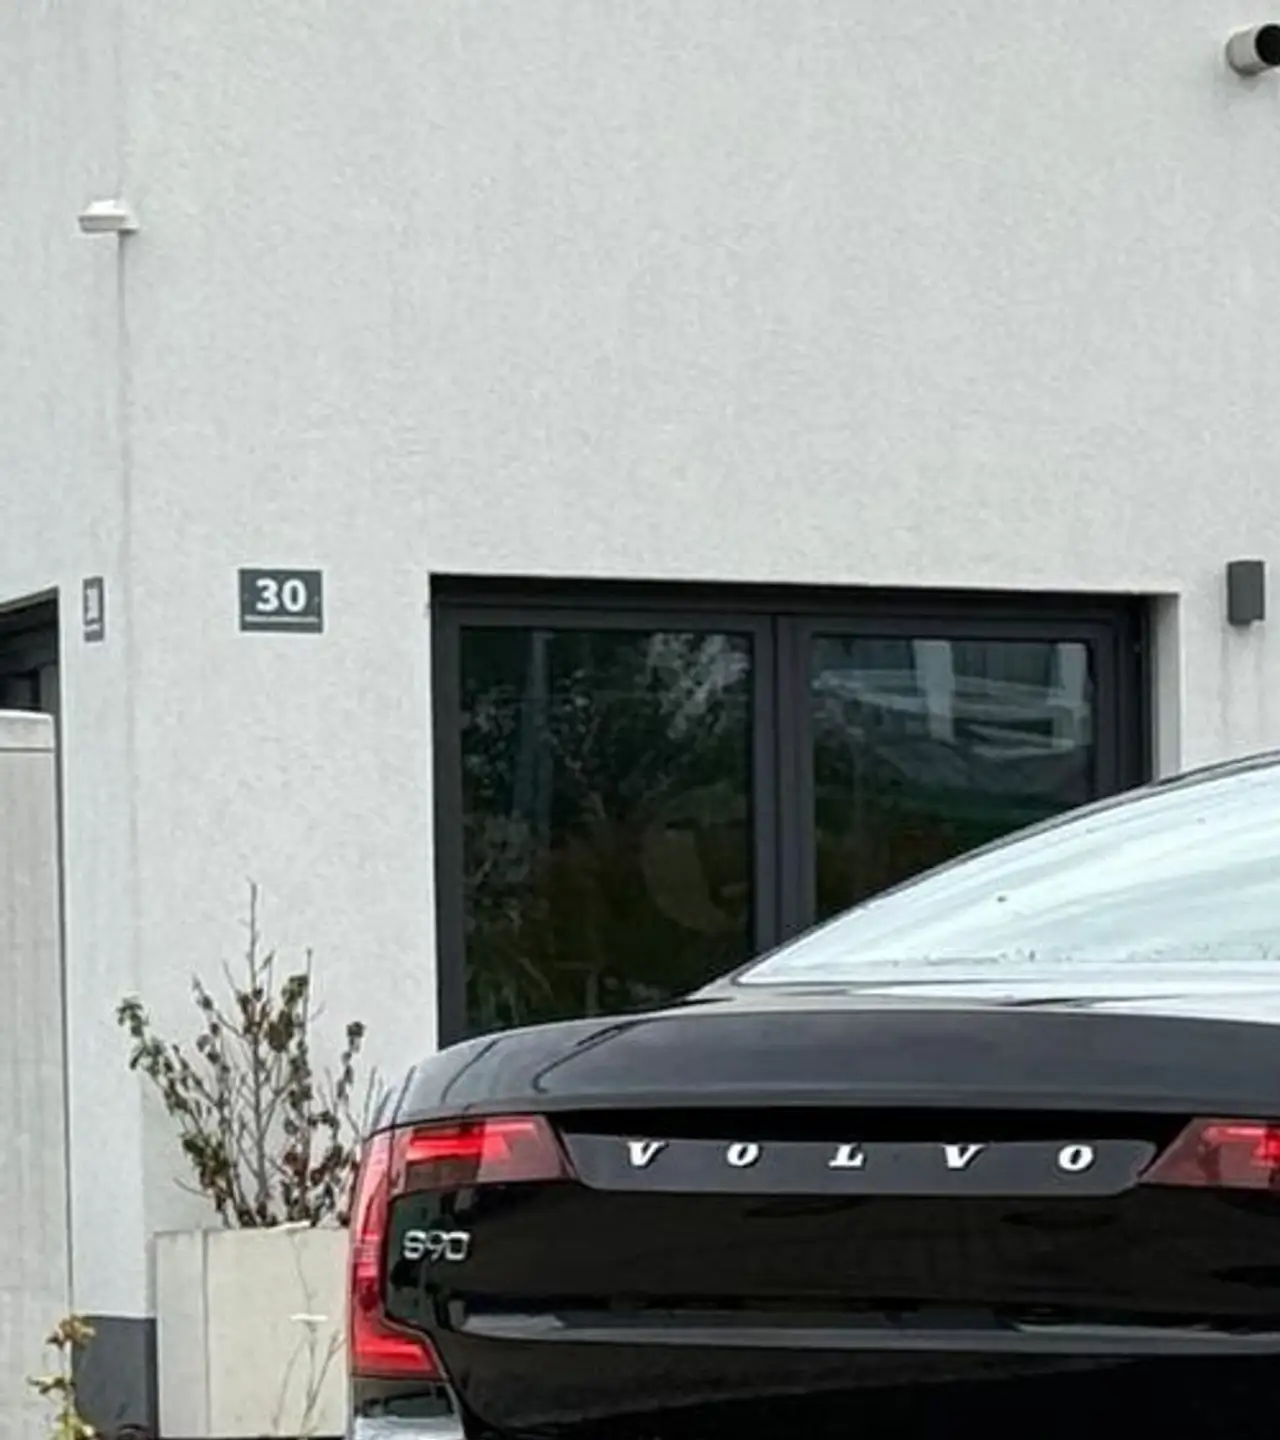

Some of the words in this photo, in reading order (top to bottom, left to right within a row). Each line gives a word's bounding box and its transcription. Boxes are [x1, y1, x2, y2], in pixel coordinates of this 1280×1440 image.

[255, 578, 307, 613] 30
[627, 1141, 1095, 1172] VOLVO
[403, 1229, 471, 1262] S90
